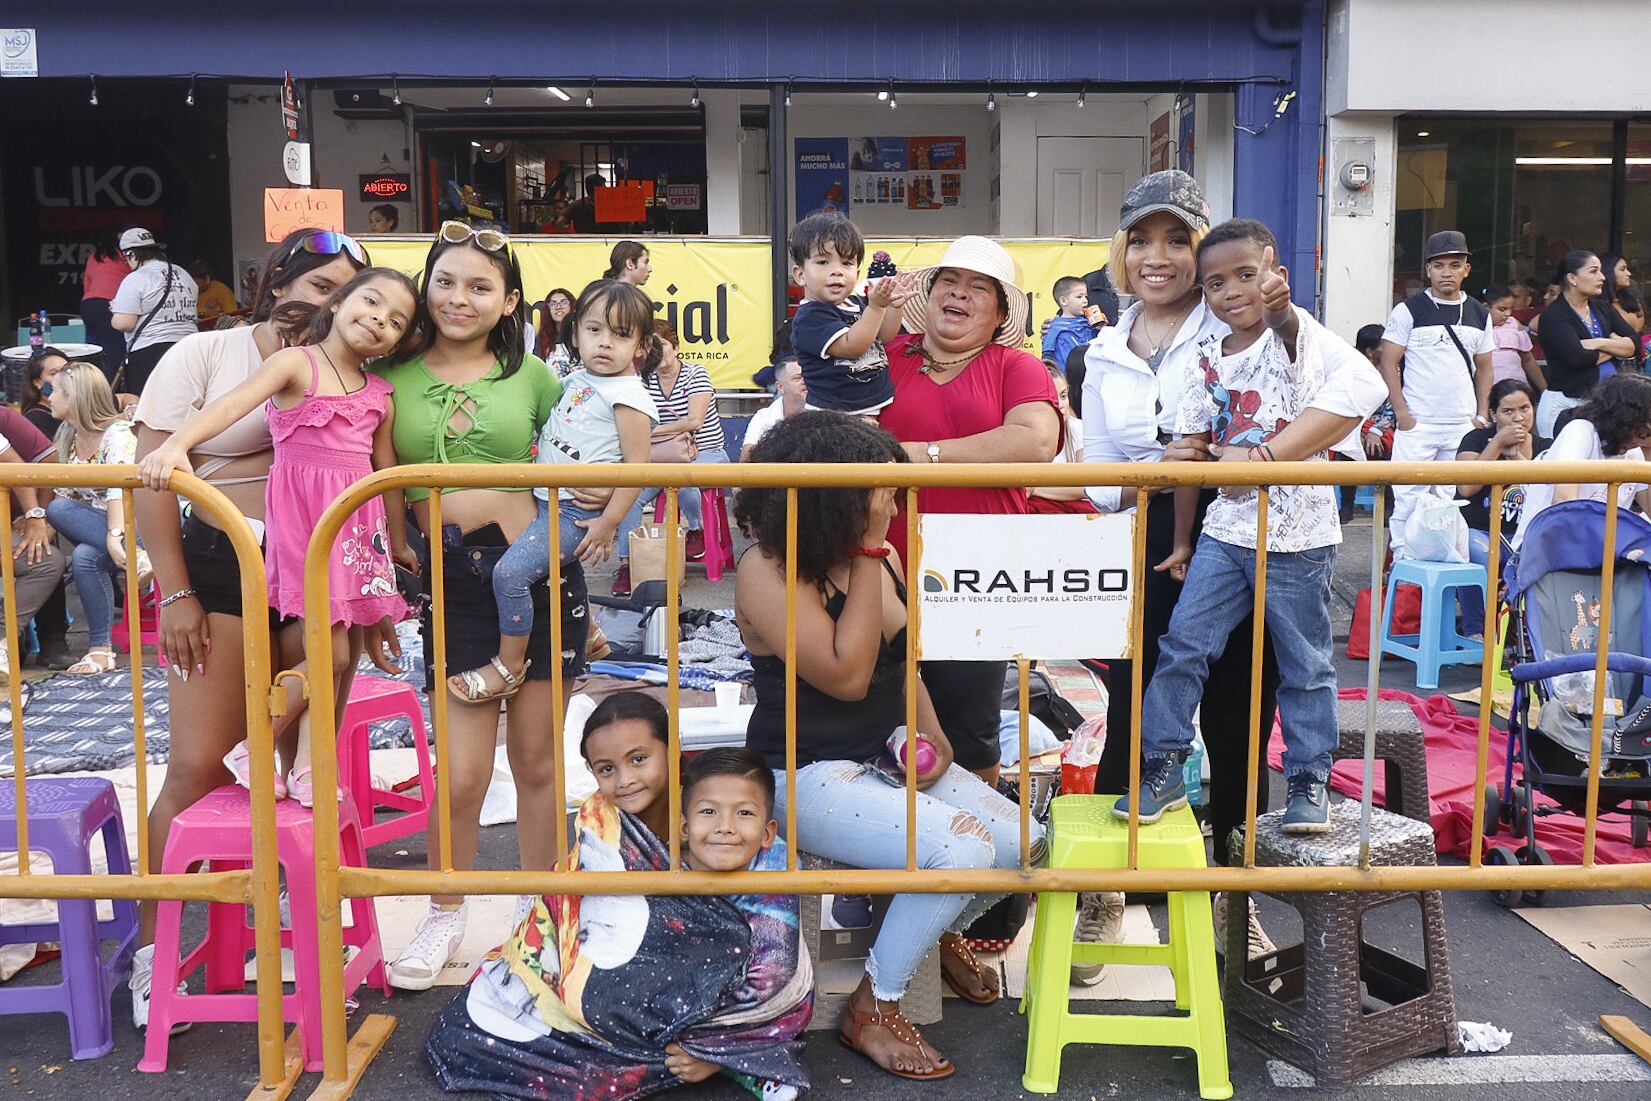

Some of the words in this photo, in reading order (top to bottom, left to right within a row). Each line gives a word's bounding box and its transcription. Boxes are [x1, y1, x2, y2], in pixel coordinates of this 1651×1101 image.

[5, 33, 27, 46] MSJ
[800, 162, 828, 170] MUCHO
[33, 165, 163, 207] LIKO
[364, 183, 408, 192] ABIERTO
[268, 190, 329, 213] Venta
[671, 197, 698, 206] OPEN
[39, 243, 98, 265] EXP
[676, 352, 703, 360] OSTA
[706, 351, 730, 360] RICA
[953, 569, 1128, 593] RAHSO
[968, 595, 992, 603] VENTA
